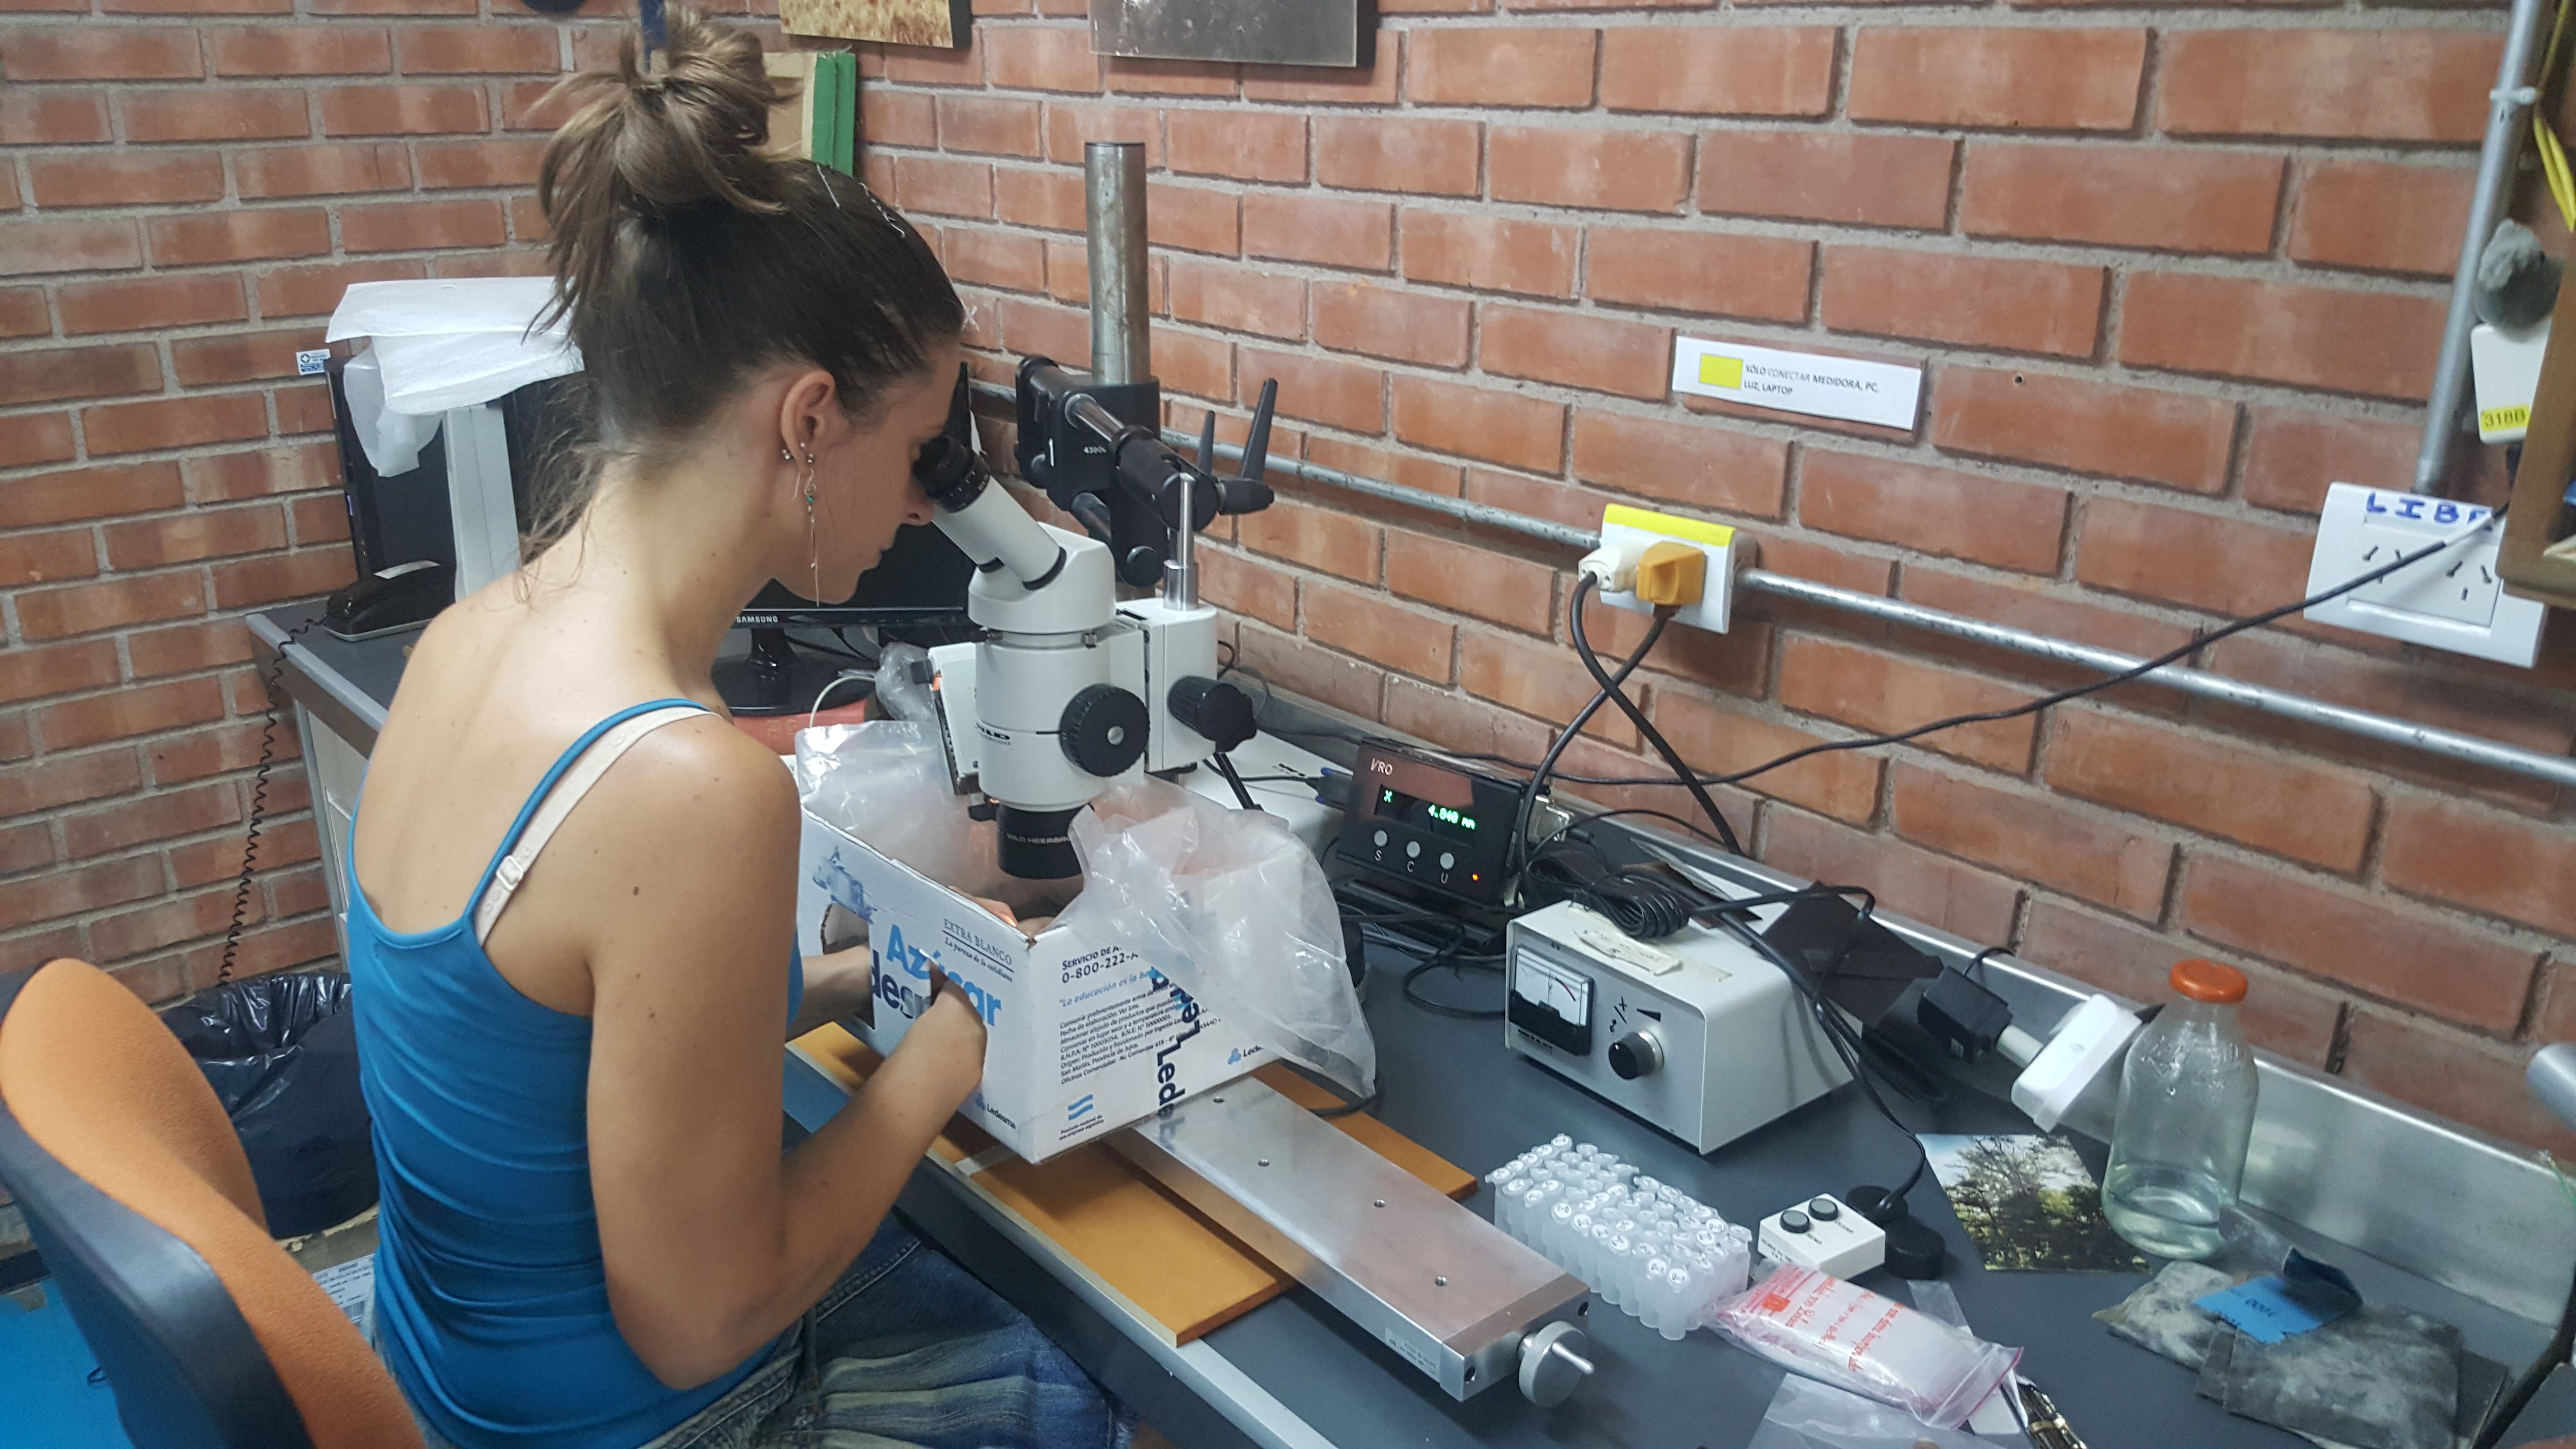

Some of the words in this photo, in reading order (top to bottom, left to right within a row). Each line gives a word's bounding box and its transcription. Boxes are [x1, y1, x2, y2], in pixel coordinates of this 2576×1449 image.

[1745, 364, 1766, 376] SÓLO
[1767, 367, 1810, 382] CONECTAR
[1762, 384, 1793, 395] LAPTOP
[1370, 758, 1393, 776] VRO
[1383, 789, 1393, 803] X
[1027, 835, 1071, 845] HEERBRU
[1374, 849, 1382, 862] S
[1406, 861, 1415, 873] C
[1440, 872, 1449, 884] U
[943, 917, 972, 943] EXTRA
[975, 934, 1012, 965] BLANCO
[1062, 951, 1098, 970] SERVICIO
[1100, 947, 1111, 957] DE
[986, 1103, 1016, 1130] Ledesma
